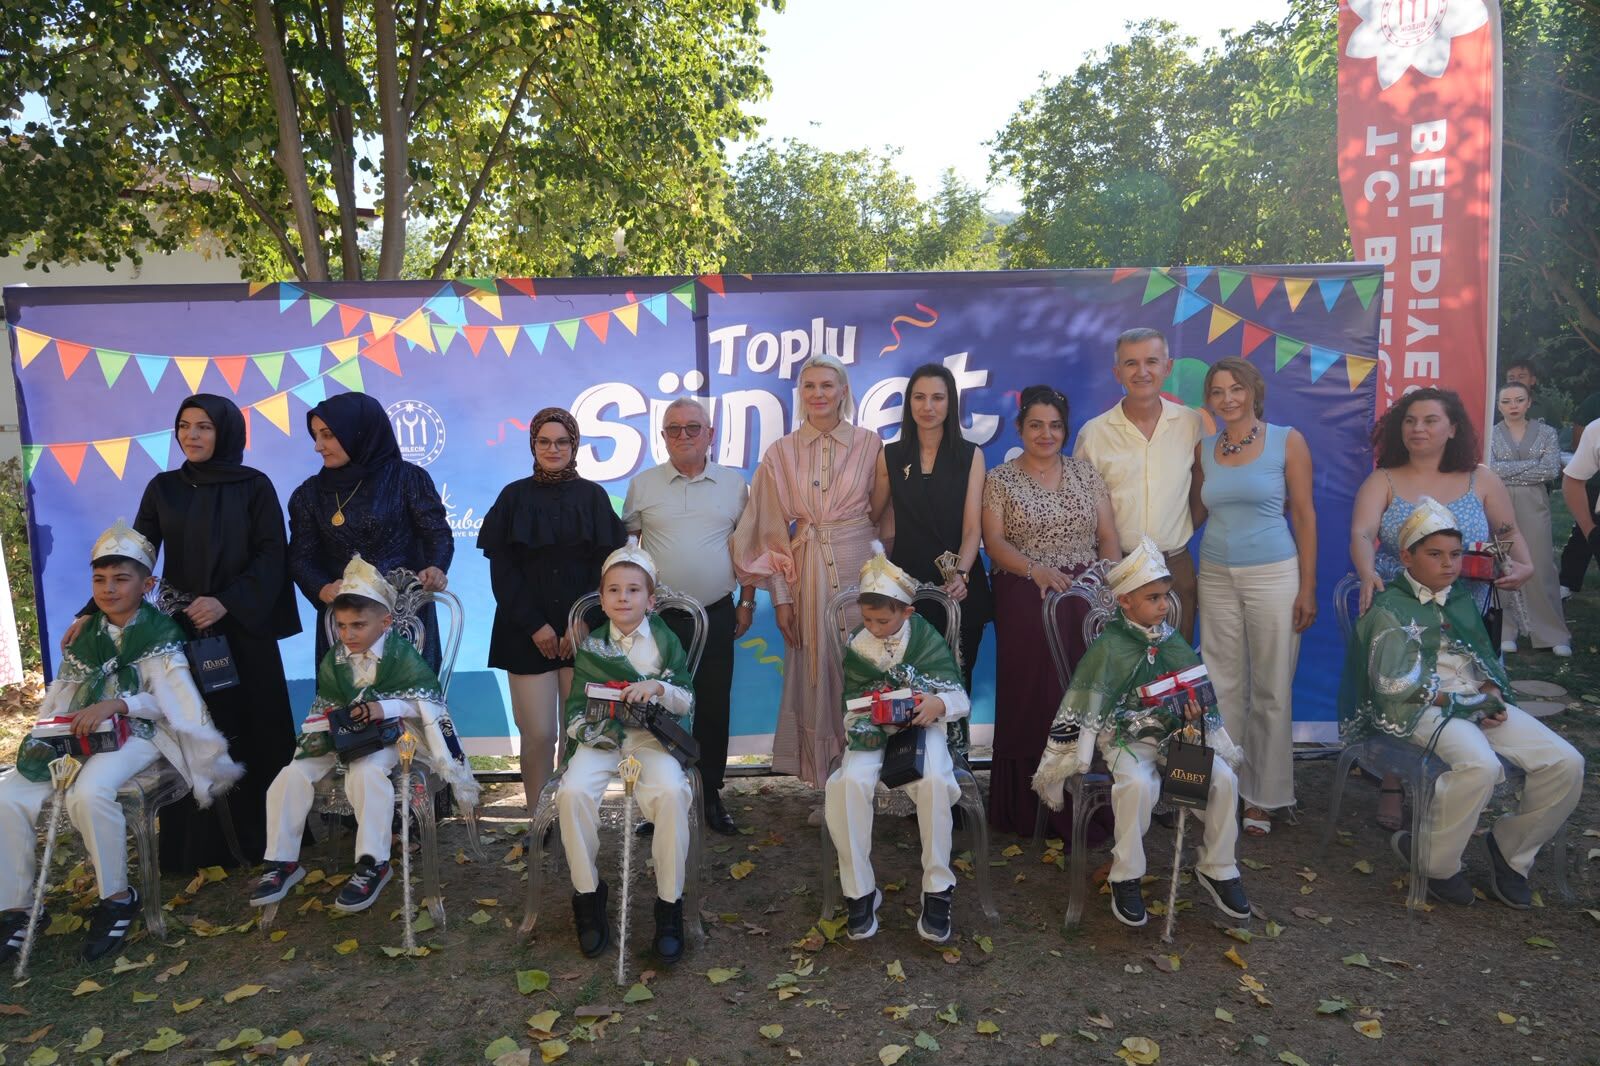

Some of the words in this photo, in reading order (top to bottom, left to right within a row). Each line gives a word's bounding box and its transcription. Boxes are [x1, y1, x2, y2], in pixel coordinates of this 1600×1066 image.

[708, 317, 857, 380] Toplu
[570, 352, 1000, 482] Sünet
[1169, 768, 1206, 783] ATABEY
